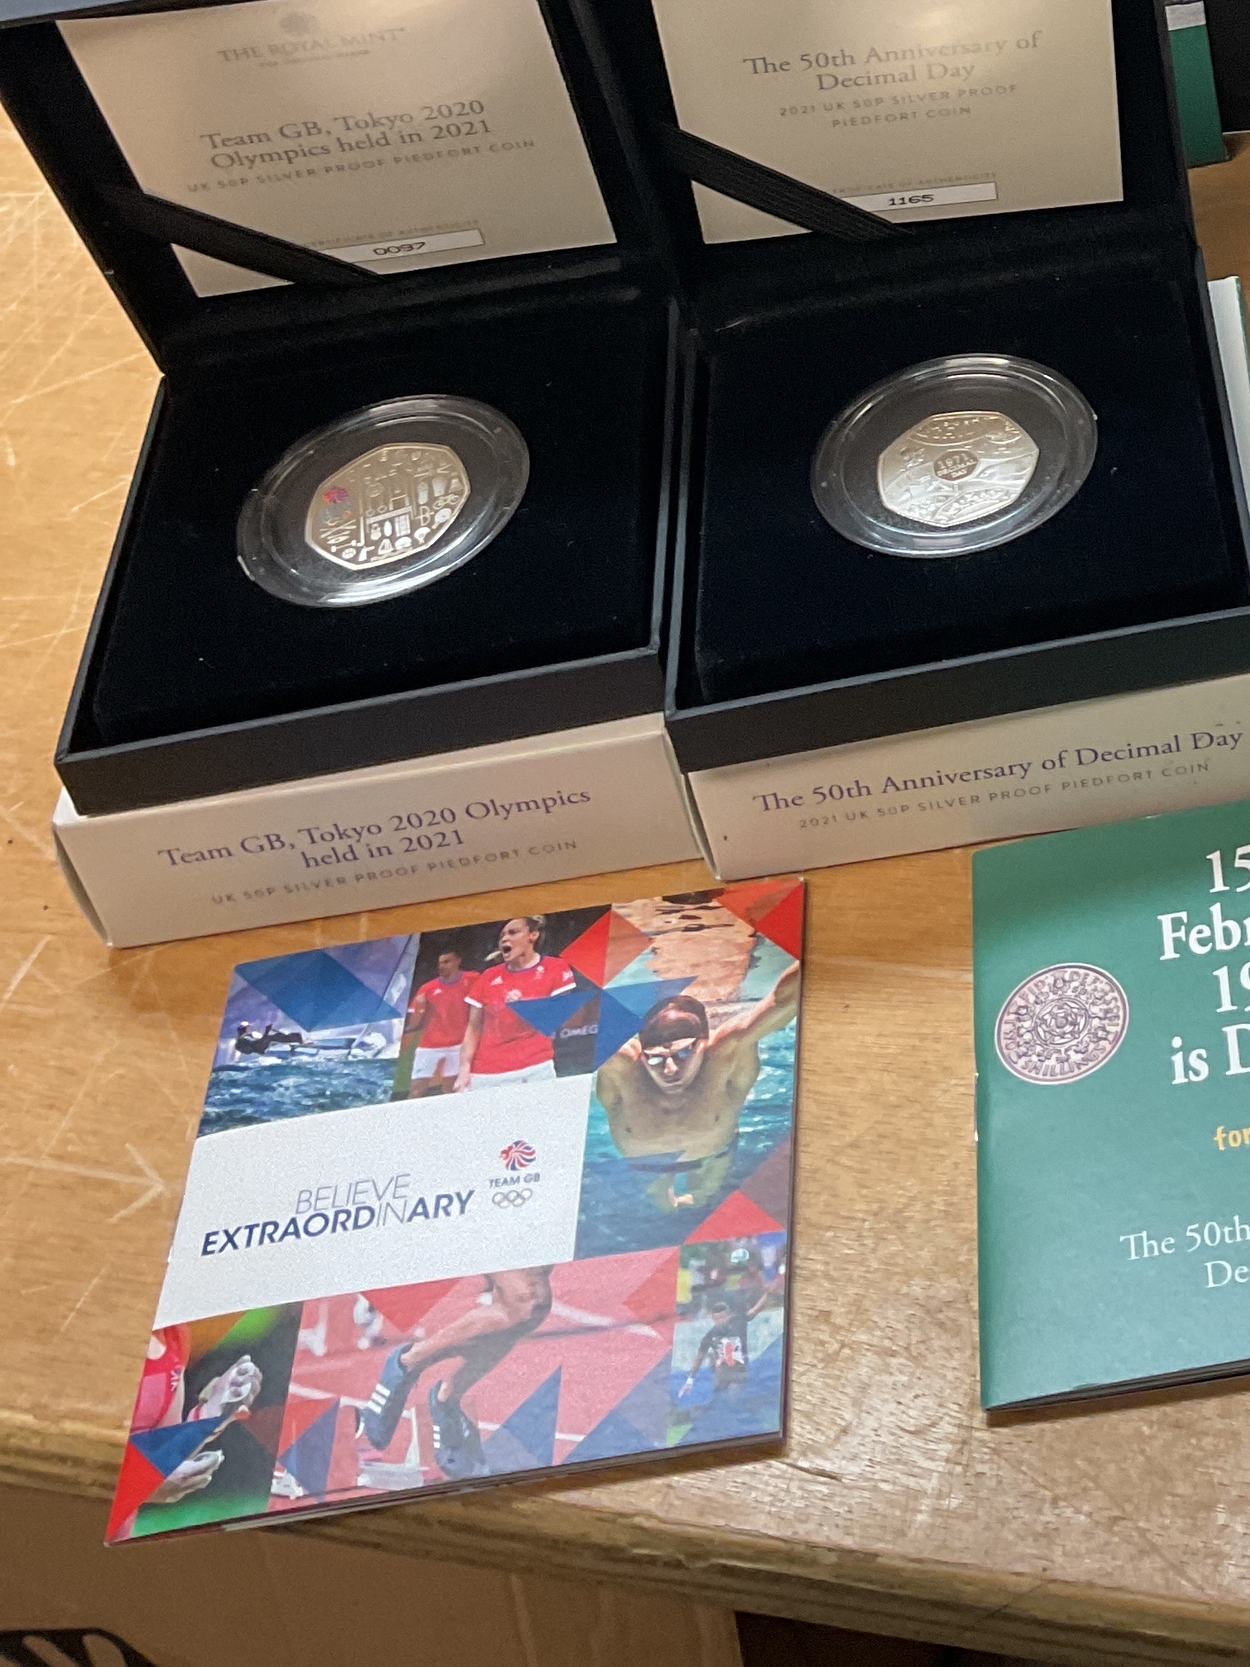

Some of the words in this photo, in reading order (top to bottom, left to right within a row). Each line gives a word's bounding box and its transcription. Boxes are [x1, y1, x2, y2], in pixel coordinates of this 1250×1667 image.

[217, 44, 263, 63] THE
[267, 34, 339, 57] ROYAL
[743, 56, 791, 76] The
[800, 48, 855, 70] 50th
[864, 36, 1008, 65] Anniversary
[1016, 30, 1043, 50] of
[816, 66, 917, 92] Decimal
[927, 60, 976, 83] Day
[779, 103, 817, 117] 2021
[823, 99, 847, 112] UK
[891, 90, 951, 107] SILVER
[957, 83, 1019, 100] PROOF
[831, 110, 919, 129] PIEDFORT
[925, 105, 972, 119] COIN
[199, 129, 271, 152] Team
[279, 120, 333, 142] GB,
[332, 110, 415, 137] Tokyo
[423, 99, 486, 122] 2020
[210, 139, 331, 176] Olympics
[336, 134, 392, 156] held
[399, 129, 425, 146] in
[431, 118, 492, 141] 2021
[256, 167, 318, 185] SILVER
[323, 158, 386, 176] PROOF
[393, 144, 484, 166] PIEDFORT
[489, 138, 536, 155] COIN
[888, 193, 935, 207] 1165
[373, 241, 426, 257] 0097
[752, 789, 806, 814] The
[811, 776, 873, 805] 50th
[880, 758, 1034, 795] Anniversary
[1040, 749, 1071, 772] of
[1075, 734, 1183, 767] Decimal
[1190, 729, 1246, 753] Day
[799, 813, 839, 829] 2021
[844, 809, 870, 822] UK
[877, 803, 911, 818] 50P
[917, 793, 982, 813] SILVER
[988, 783, 1054, 804] PROOF
[1061, 769, 1155, 794] PIEDFORT
[1161, 760, 1211, 779] COIN
[157, 841, 233, 869] Team
[240, 831, 296, 857] GB,
[297, 819, 384, 848] Tokyo
[388, 806, 458, 834] 2020
[465, 788, 592, 822] Olympics
[299, 845, 361, 871] held
[366, 839, 394, 861] in
[400, 828, 466, 854] 2021
[210, 892, 237, 906] UK
[283, 873, 349, 896] SILVER
[353, 863, 420, 883] PROOF
[427, 847, 522, 875] PIEDFORT
[528, 839, 579, 857] COIN
[1169, 1036, 1210, 1086] is
[295, 1172, 412, 1216] BELIEVE
[488, 1174, 521, 1189] TEAM
[523, 1172, 541, 1184] GB
[201, 1189, 476, 1258] EXTRAORDINARY
[1119, 1229, 1177, 1262] The
